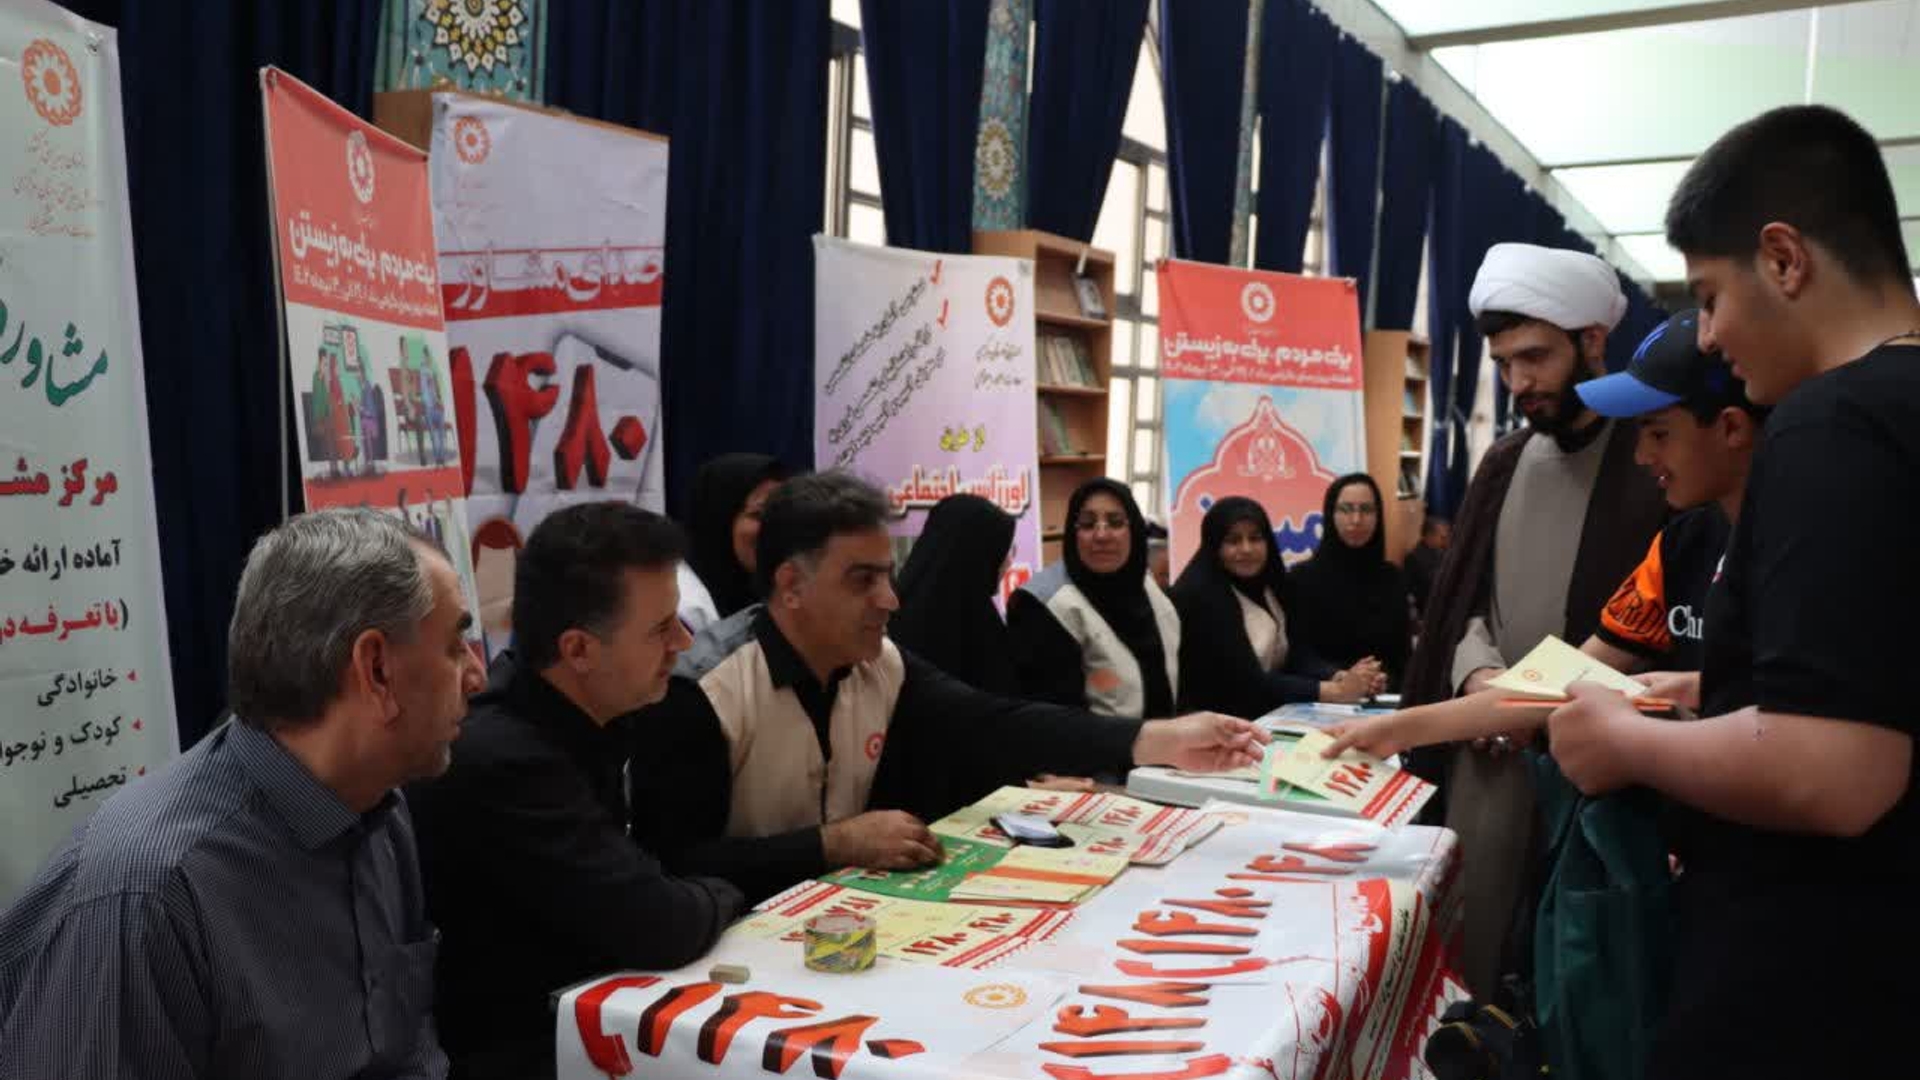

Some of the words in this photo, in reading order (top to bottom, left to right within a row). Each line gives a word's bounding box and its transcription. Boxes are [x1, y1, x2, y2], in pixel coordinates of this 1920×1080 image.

[451, 240, 566, 311] مشاور
[566, 238, 661, 302] صدای
[0, 298, 108, 406] مشاور
[448, 345, 648, 499] ۱۴۸۰
[971, 425, 985, 452] از
[0, 457, 50, 495] مش
[59, 458, 118, 507] مرکز
[22, 544, 67, 580] ارائه
[73, 539, 121, 570] آماده
[37, 668, 118, 706] خانوادگی
[0, 731, 46, 766] نوجوا
[54, 735, 63, 755] و
[70, 716, 121, 746] کودک
[54, 767, 126, 808] تحصیلی
[1087, 837, 1127, 856] ۴۸۰
[1115, 886, 1274, 955] ۱۴۸۰
[636, 980, 926, 1079] ۱۴۸۰
[1037, 980, 1213, 1058] ۱۴۸
